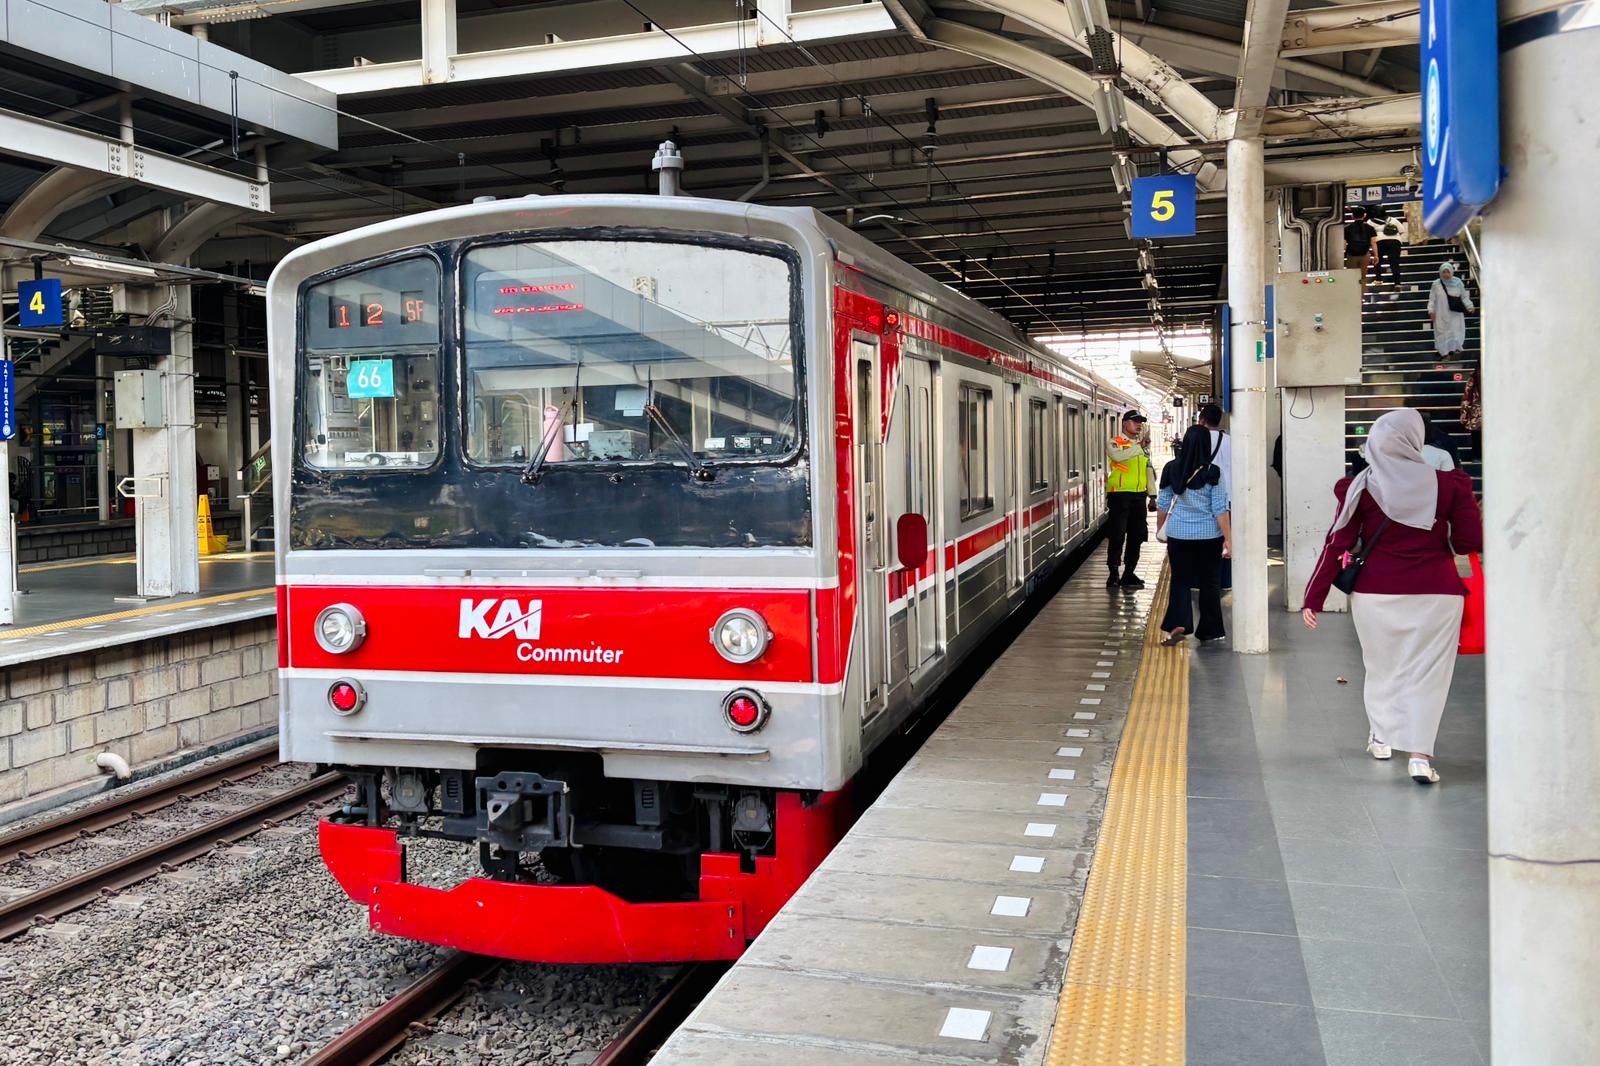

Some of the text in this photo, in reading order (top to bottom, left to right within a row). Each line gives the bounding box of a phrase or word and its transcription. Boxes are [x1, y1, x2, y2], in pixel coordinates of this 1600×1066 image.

[1150, 190, 1175, 222] 5
[29, 291, 45, 315] 4
[340, 300, 424, 327] 1 2 SF
[357, 366, 382, 388] 66
[458, 598, 543, 640] KAI
[516, 641, 624, 664] Commuter
